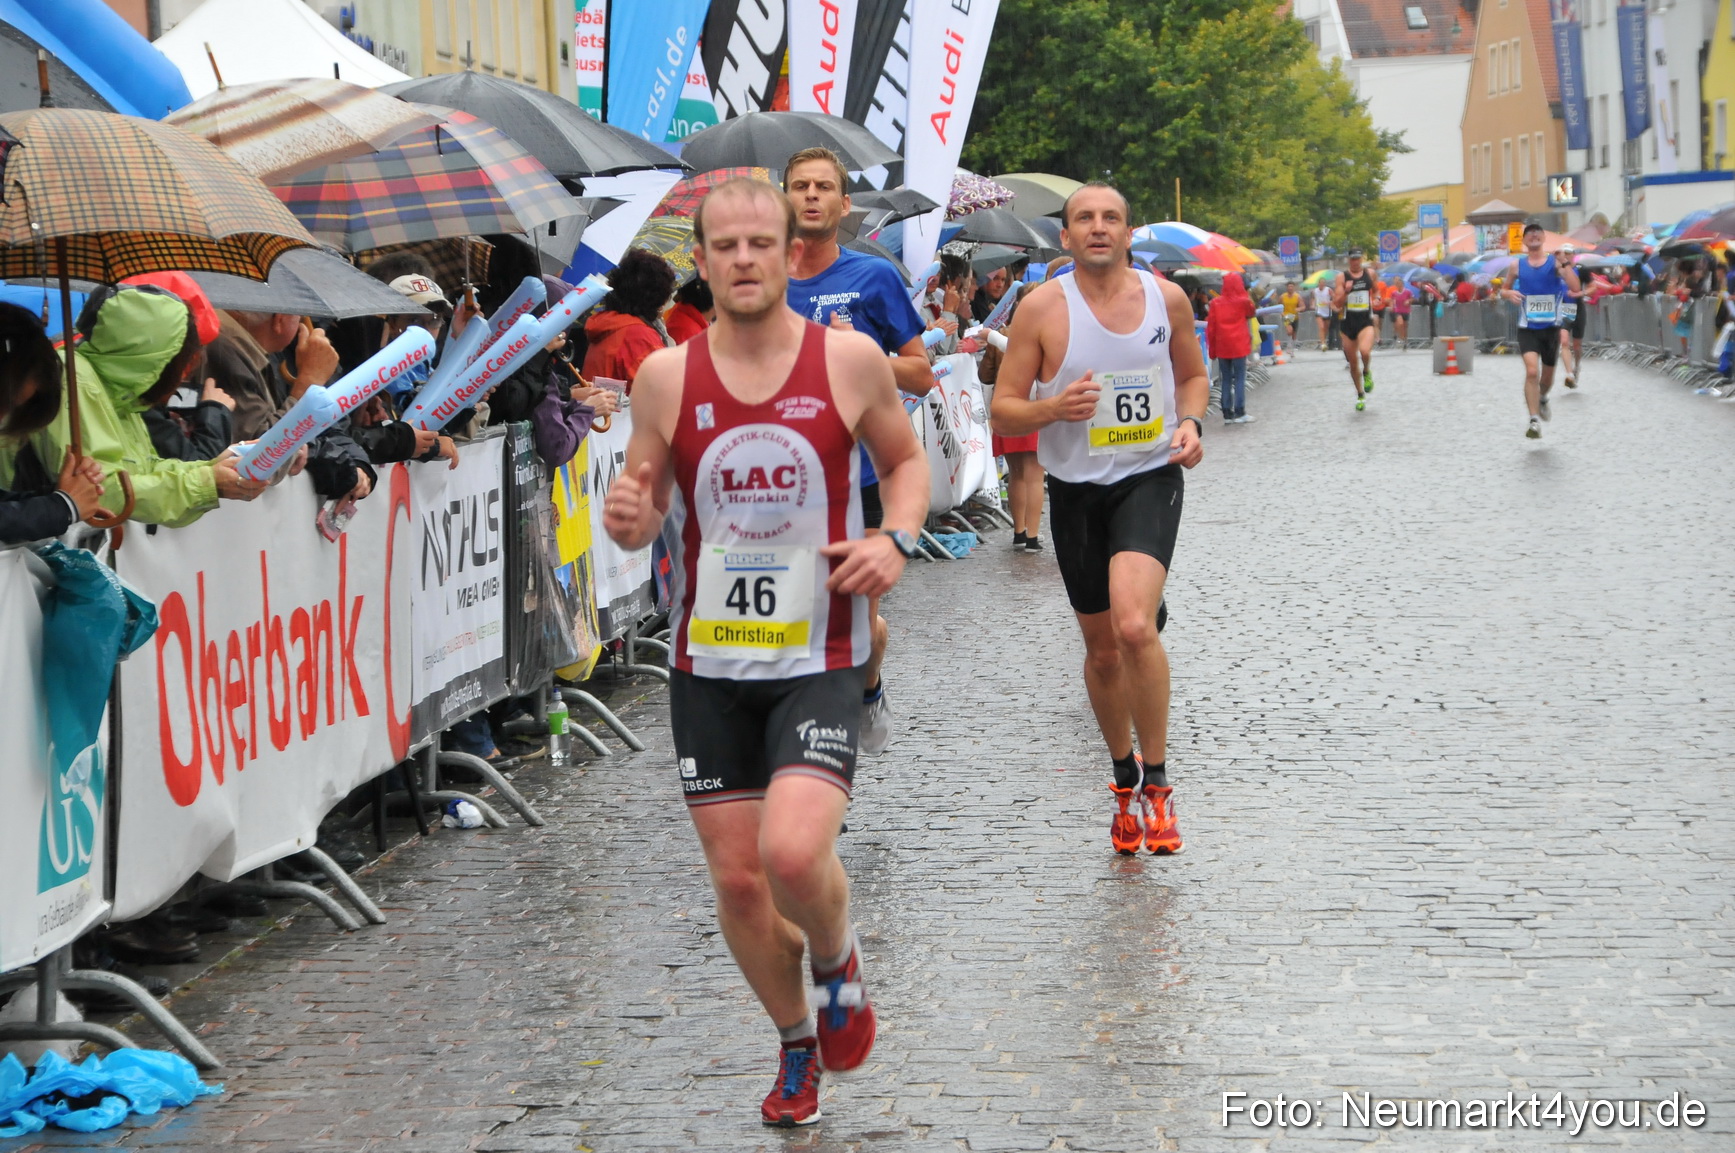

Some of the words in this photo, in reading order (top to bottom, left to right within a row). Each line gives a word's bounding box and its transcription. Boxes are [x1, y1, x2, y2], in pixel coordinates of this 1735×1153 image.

[931, 28, 964, 146] Audi
[1282, 256, 1299, 264] TAXI
[1382, 252, 1400, 262] TAXI
[817, 298, 851, 307] STADTLAUF
[819, 292, 860, 301] NEUMARKTER
[1530, 301, 1553, 312] 2070
[336, 344, 429, 414] ReiseCenter
[431, 394, 458, 422] TUI
[455, 334, 530, 404] ReiseCenter
[774, 396, 798, 411] TEAM
[799, 396, 827, 411] SPORT
[1116, 392, 1151, 423] 63
[252, 445, 274, 472] TUI
[268, 413, 318, 459] ReiseCenter
[720, 465, 796, 491] LAC
[729, 493, 789, 503] Harlekin
[725, 576, 777, 617] 46
[714, 625, 785, 645] Christian
[155, 532, 371, 807] Oberbank
